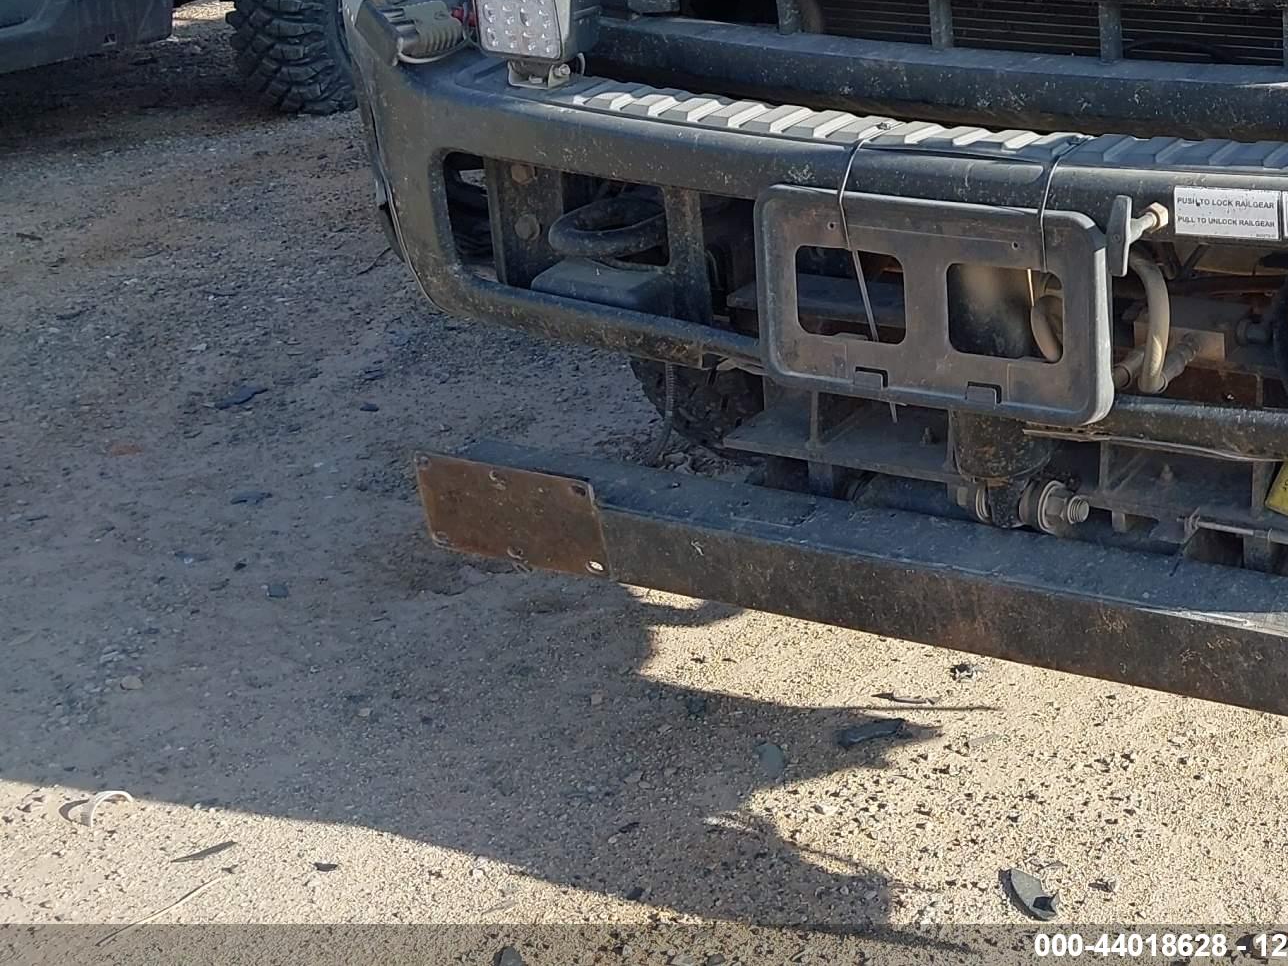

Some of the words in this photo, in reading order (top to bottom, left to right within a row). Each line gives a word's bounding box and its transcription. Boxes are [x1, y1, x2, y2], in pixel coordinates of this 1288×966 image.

[1200, 198, 1210, 206] TO
[1212, 199, 1234, 207] LOCK
[1235, 200, 1275, 209] RAILGEAR
[1177, 216, 1196, 224] PULL
[1208, 217, 1238, 226] UNLOCK
[1239, 219, 1275, 228] RAILGEAR
